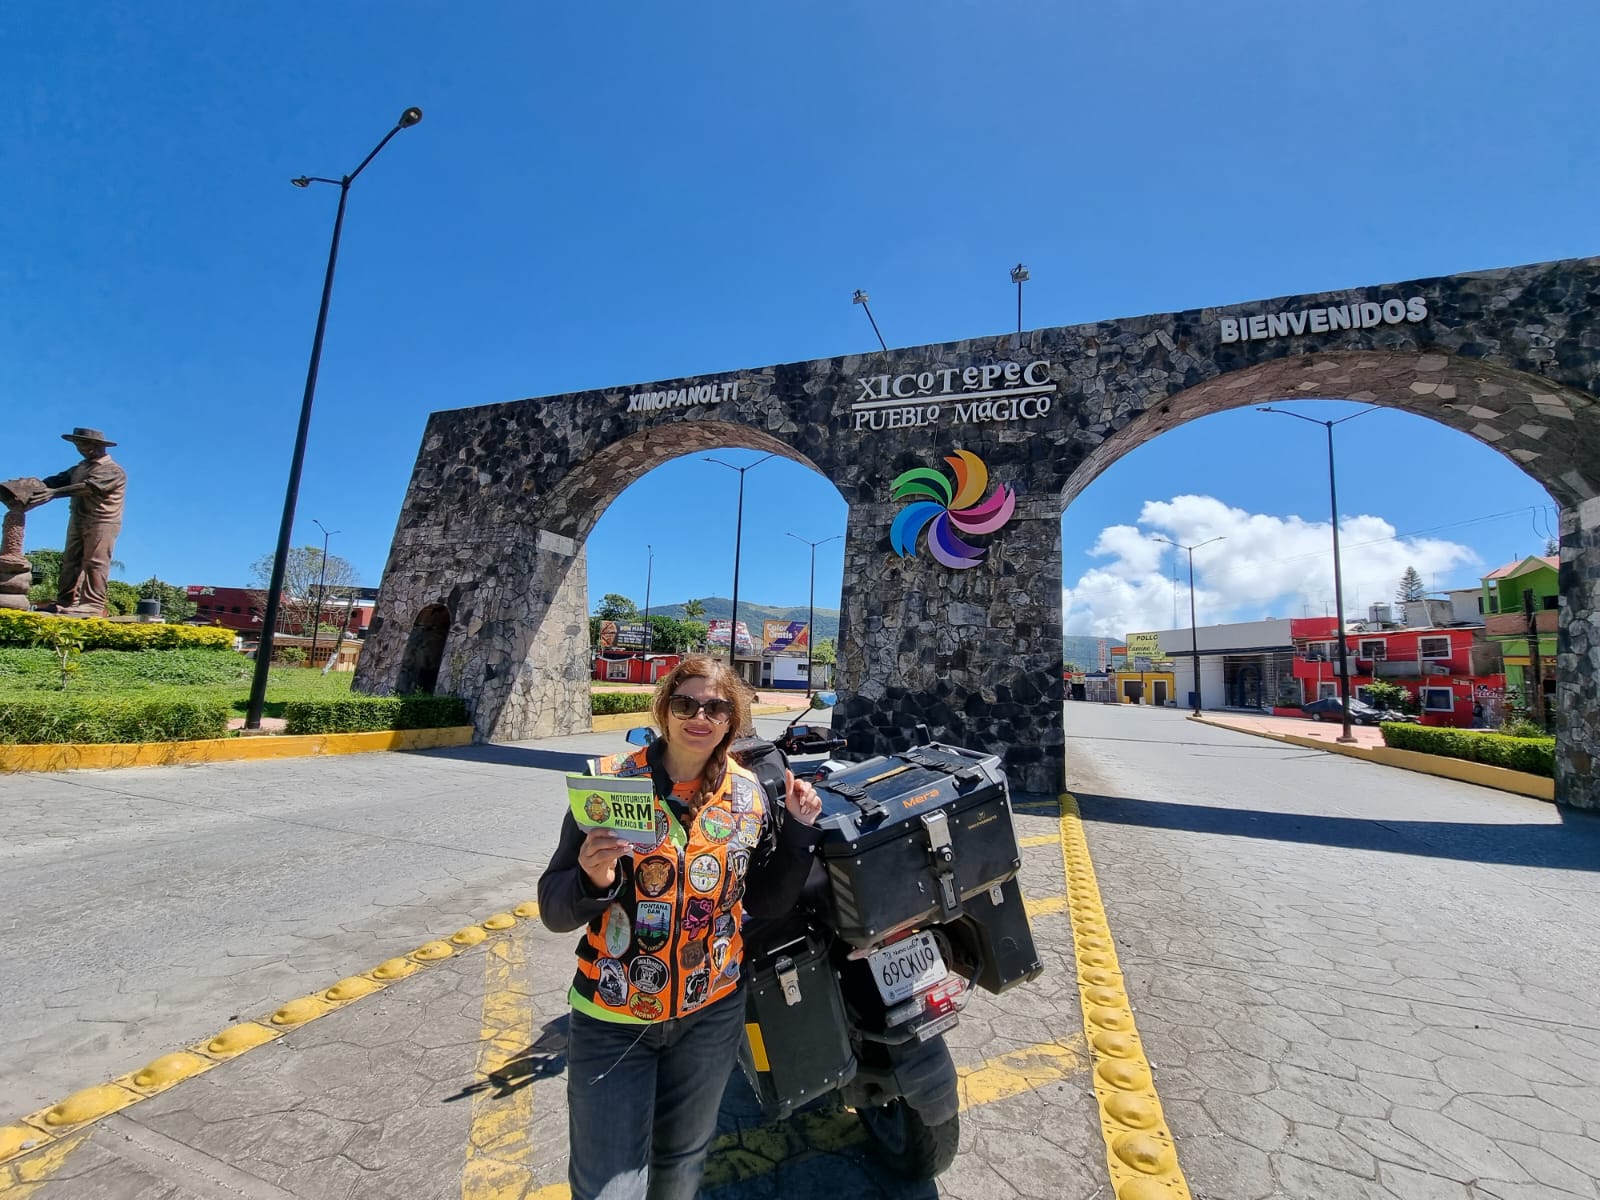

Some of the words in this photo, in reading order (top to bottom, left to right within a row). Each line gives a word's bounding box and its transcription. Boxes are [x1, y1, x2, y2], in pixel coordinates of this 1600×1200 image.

[1221, 296, 1428, 344] BIENVENIDOS
[626, 382, 739, 413] XIMOPANOLTI
[854, 406, 939, 431] PUEBLO
[610, 794, 651, 803] MOTOTURISTA
[611, 801, 652, 821] RRM
[615, 819, 637, 829] MEXICO
[640, 903, 668, 911] FONTANA
[882, 947, 935, 987] 69CKU9
